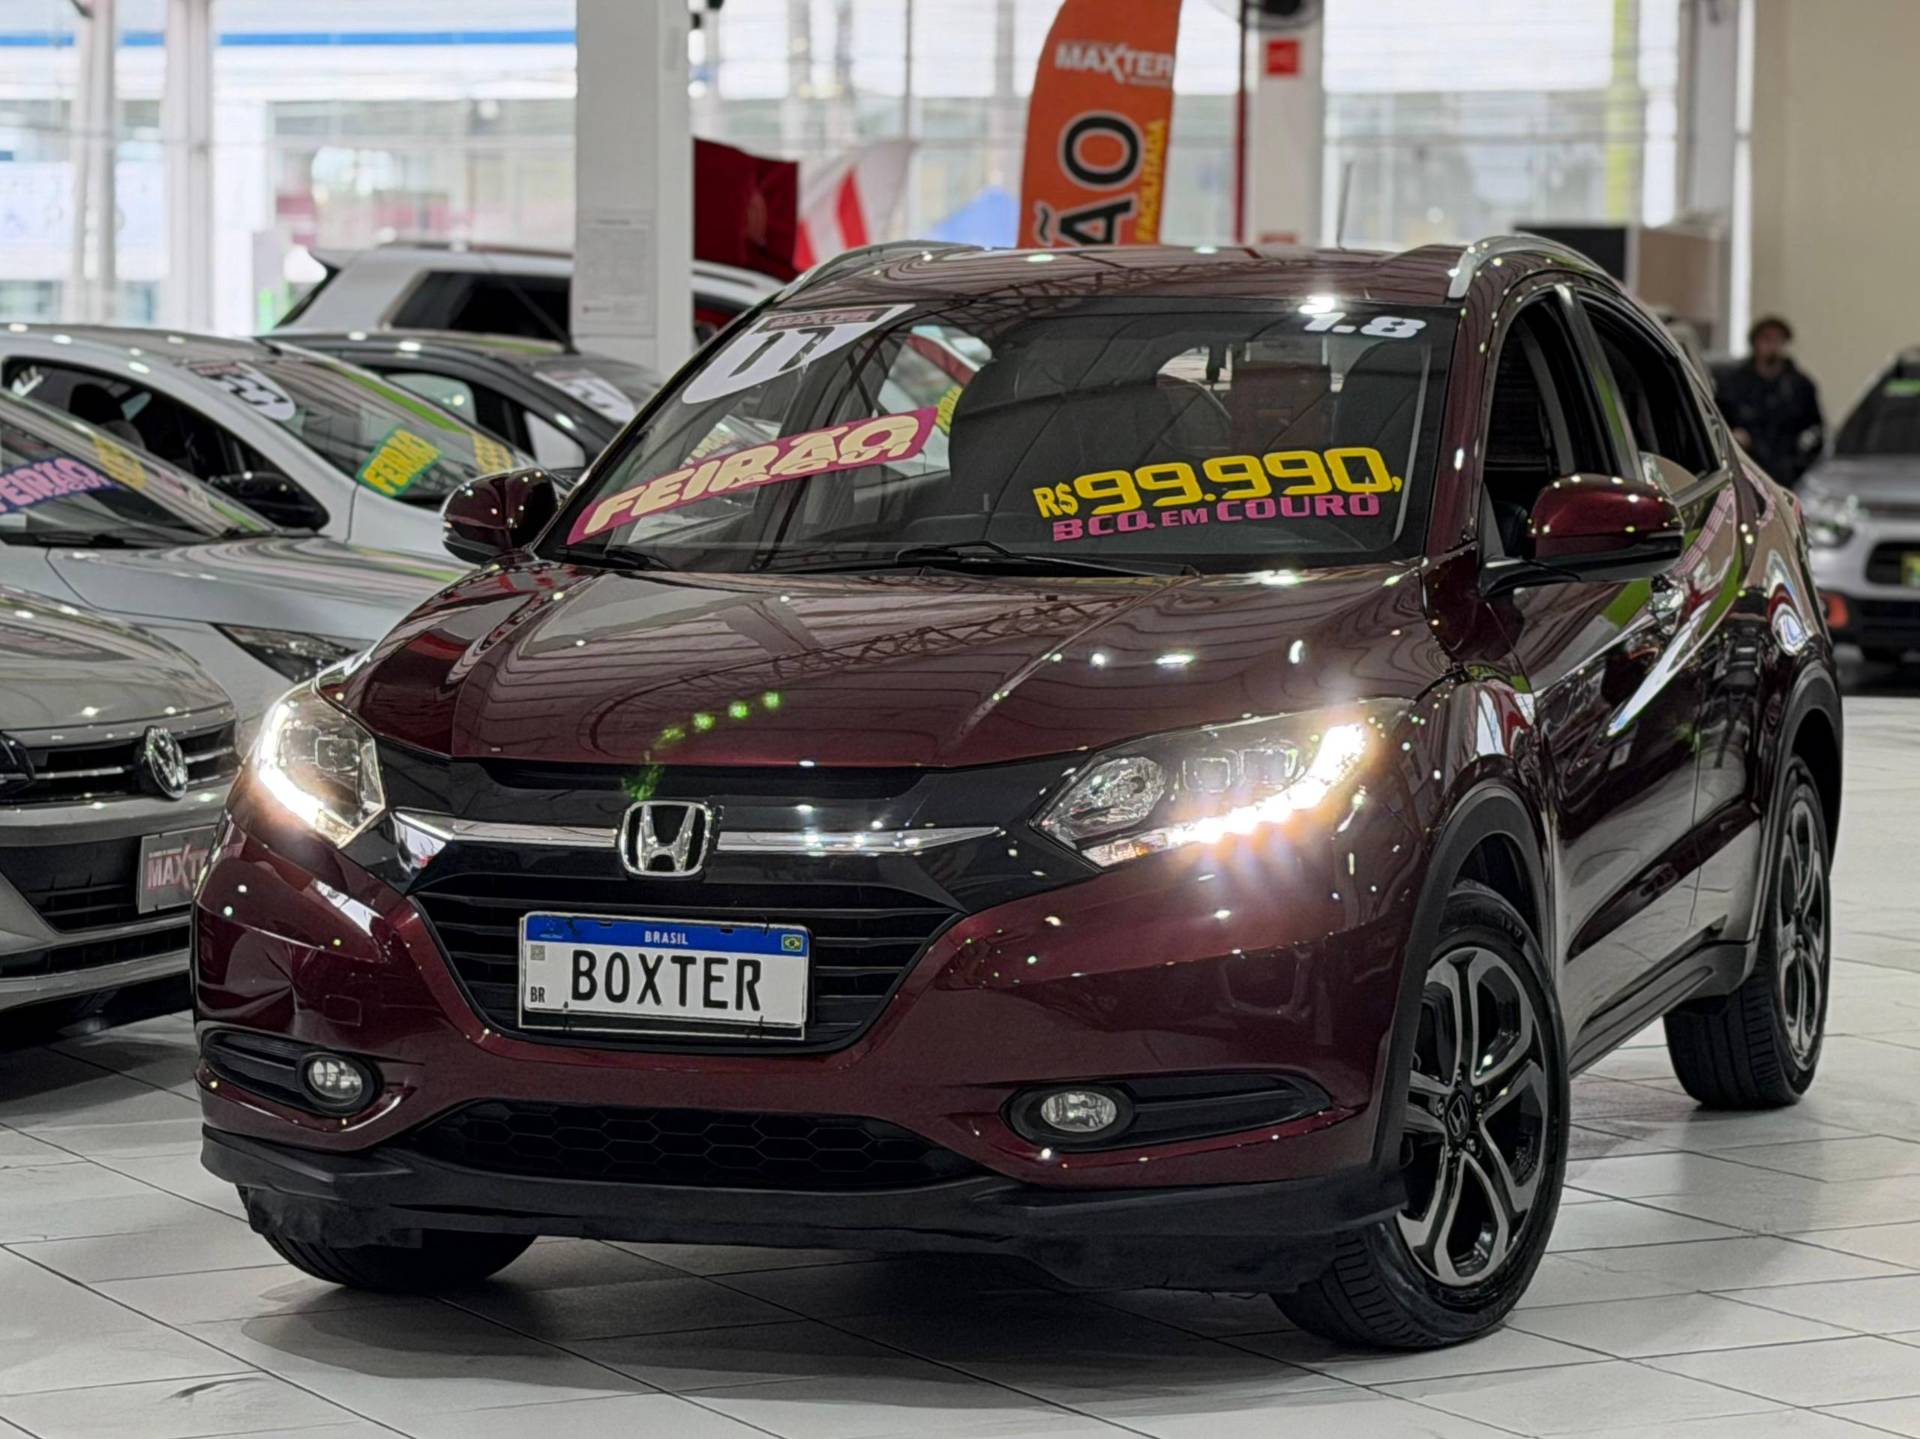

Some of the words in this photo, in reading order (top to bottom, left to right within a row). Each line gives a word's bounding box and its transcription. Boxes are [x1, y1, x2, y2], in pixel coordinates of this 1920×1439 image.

[1304, 312, 1427, 338] 1.8
[1161, 508, 1209, 527] EM
[1216, 494, 1380, 522] COURO
[644, 930, 688, 945] BRASIL
[571, 950, 761, 1011] BOXTER
[530, 986, 545, 1003] BR
